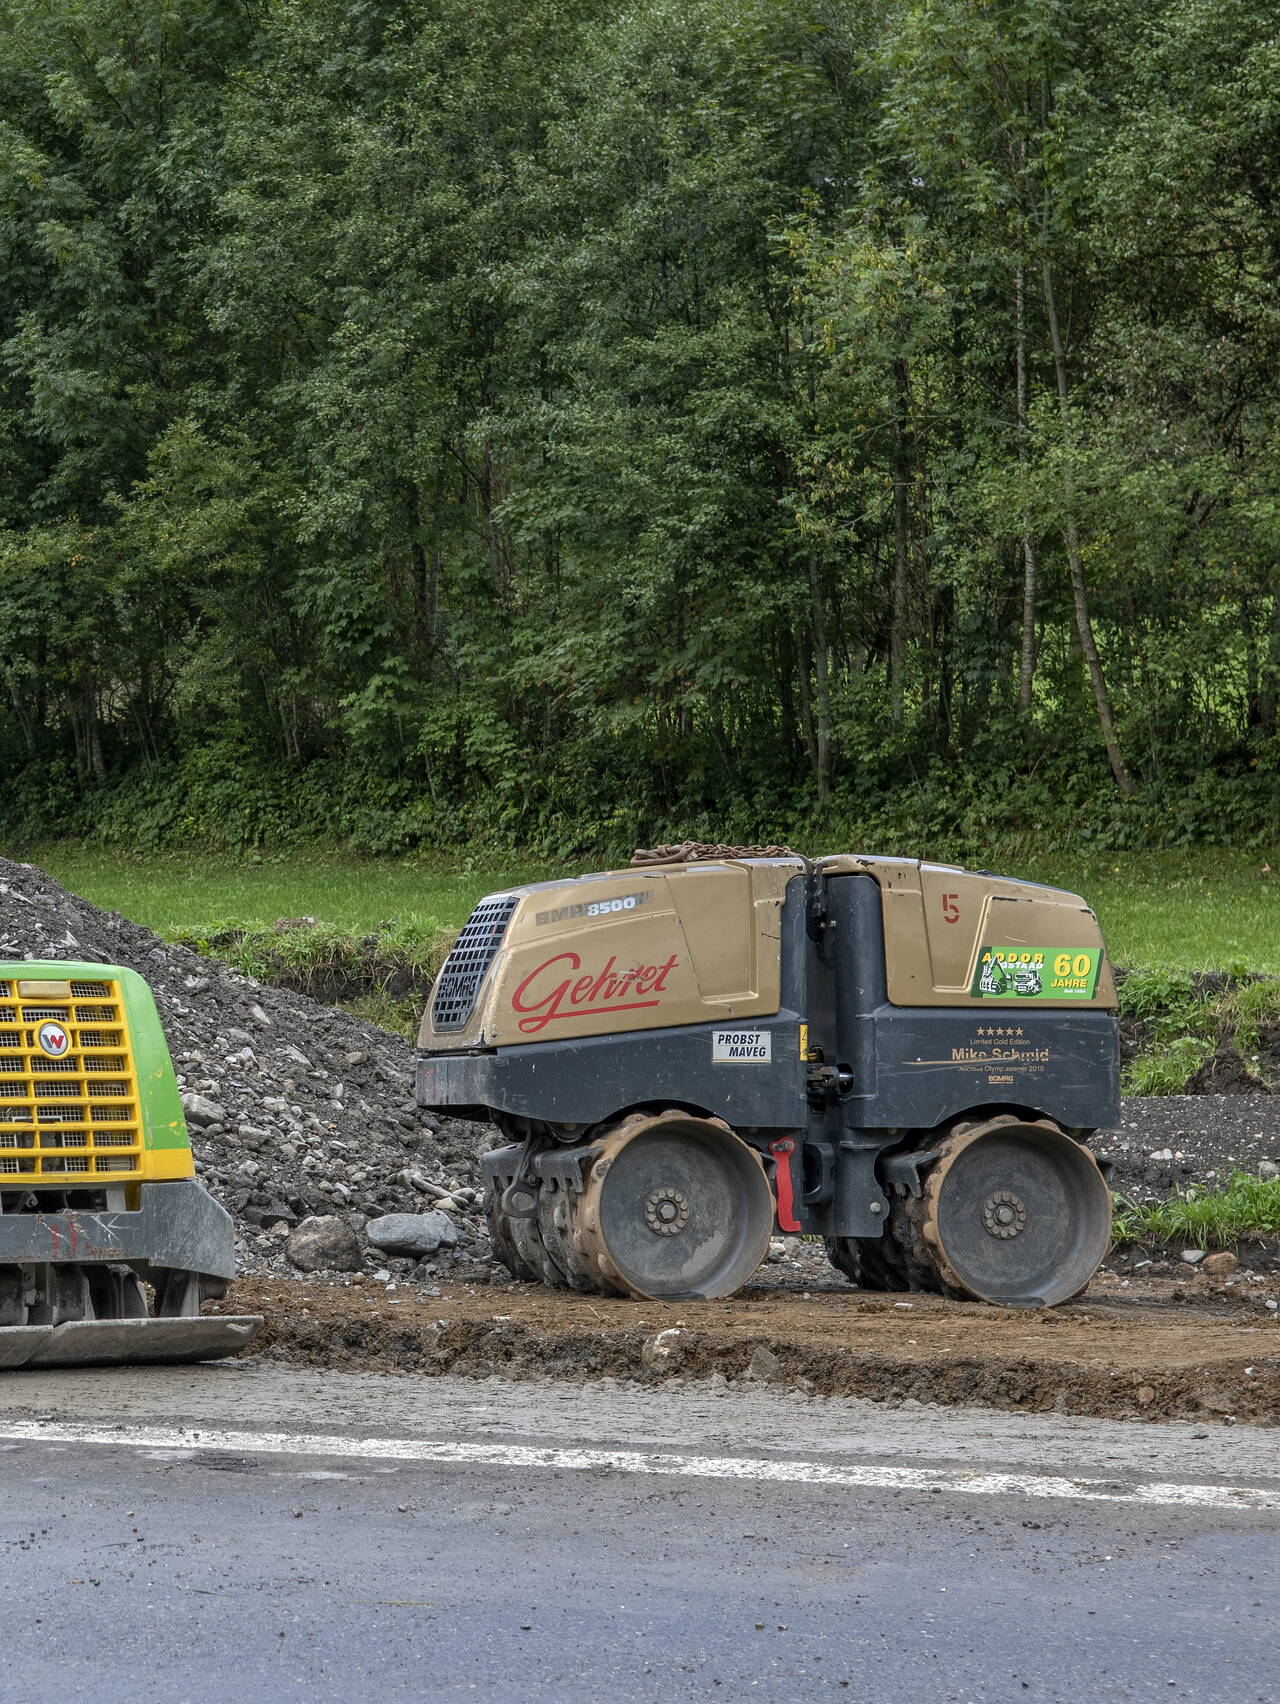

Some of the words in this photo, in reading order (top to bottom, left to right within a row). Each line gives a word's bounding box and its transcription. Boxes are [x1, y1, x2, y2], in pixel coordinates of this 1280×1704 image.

[587, 897, 636, 916] 8500
[942, 893, 960, 924] 5
[1053, 954, 1092, 977] 60
[1051, 979, 1089, 988] JAHRE
[718, 1034, 761, 1044] PROBST
[728, 1047, 767, 1057] MAVEG
[952, 1048, 987, 1060] Mike
[989, 1075, 1014, 1083] BOMAG
